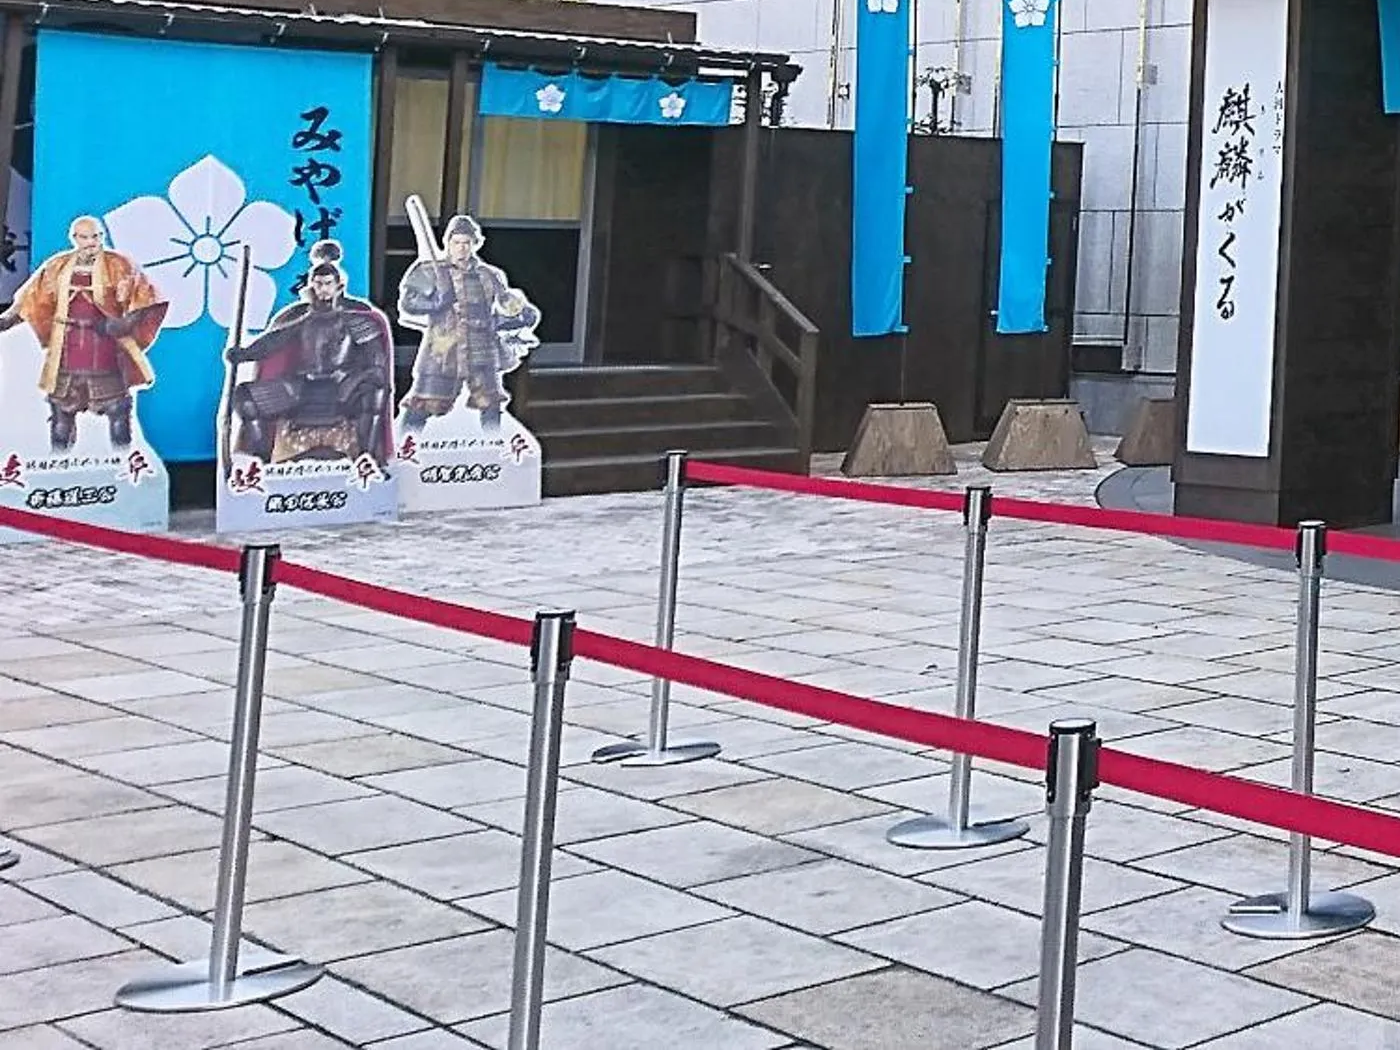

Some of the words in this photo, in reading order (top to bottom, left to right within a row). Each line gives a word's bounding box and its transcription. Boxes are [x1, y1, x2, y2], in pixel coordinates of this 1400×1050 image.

[287, 106, 342, 297] みやげ
[1210, 82, 1256, 321] 麒麟がくる
